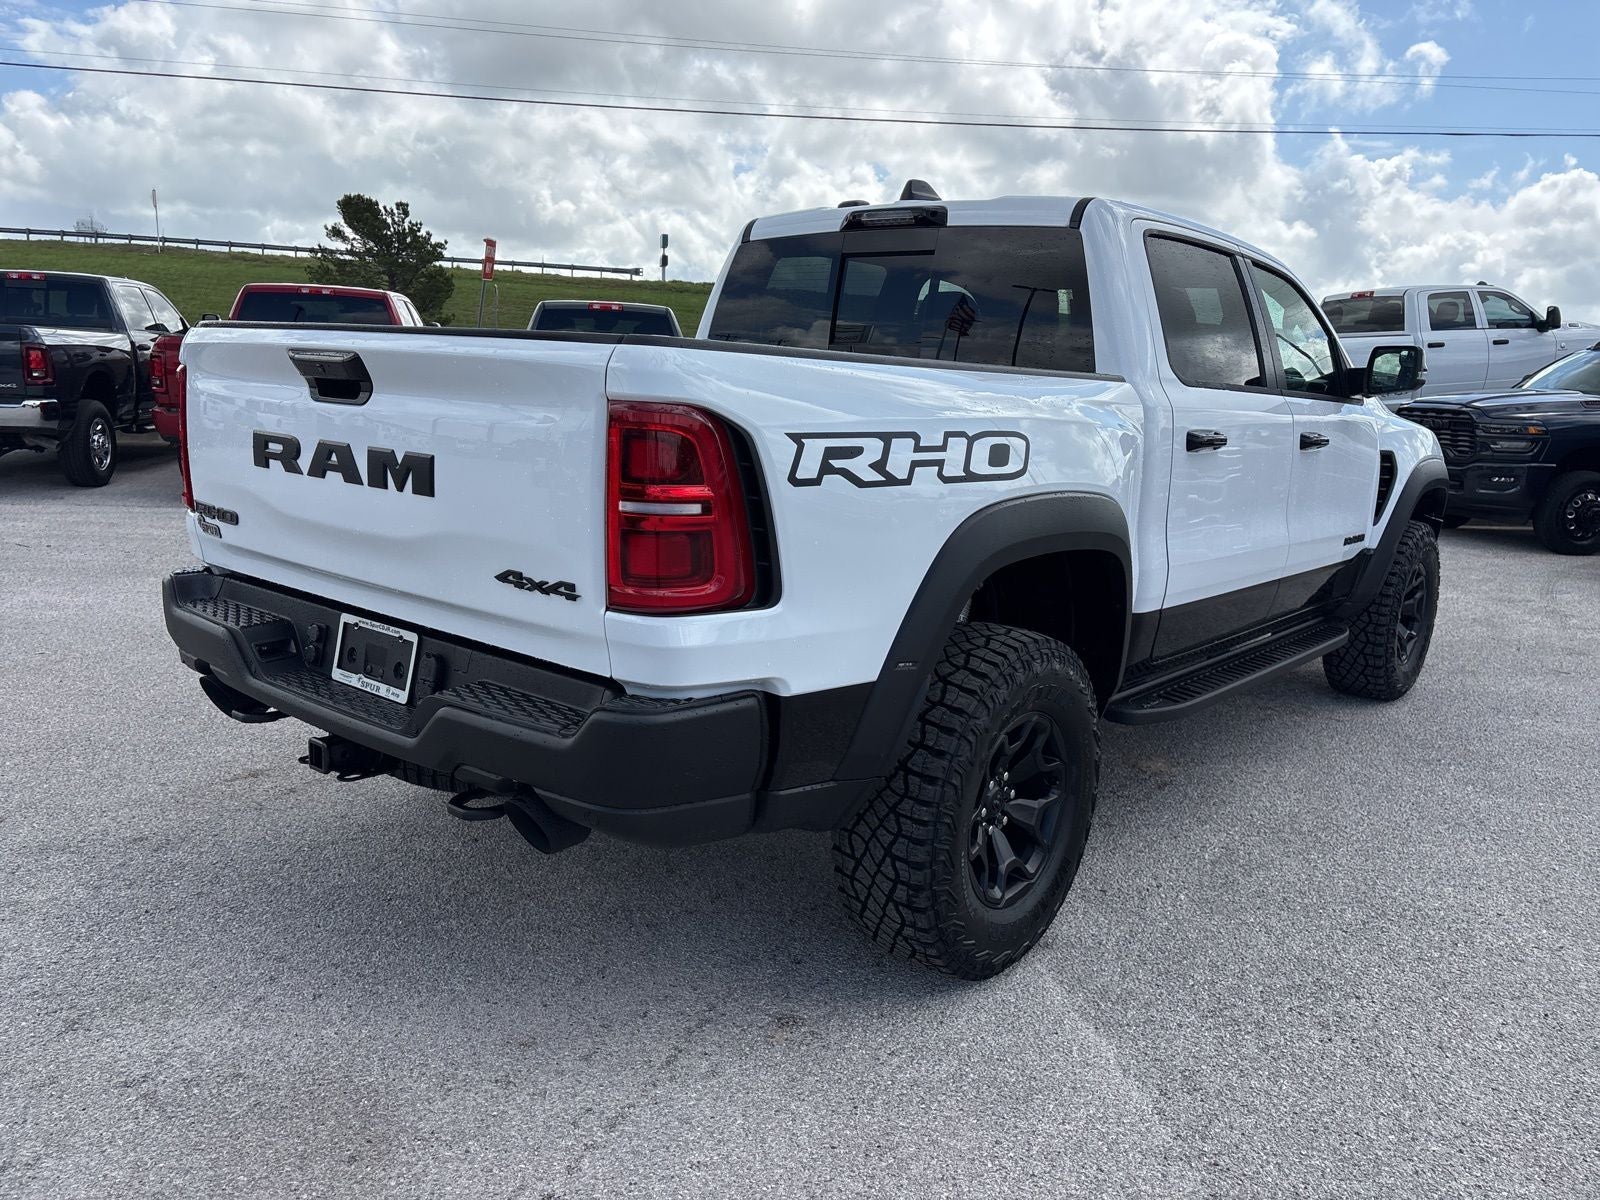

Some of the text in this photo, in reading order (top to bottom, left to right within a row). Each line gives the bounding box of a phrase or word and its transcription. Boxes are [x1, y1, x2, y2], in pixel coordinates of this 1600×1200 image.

[252, 430, 435, 498] RAM
[784, 430, 1031, 489] RHO
[195, 500, 239, 526] RHO
[360, 680, 381, 693] SPUR
